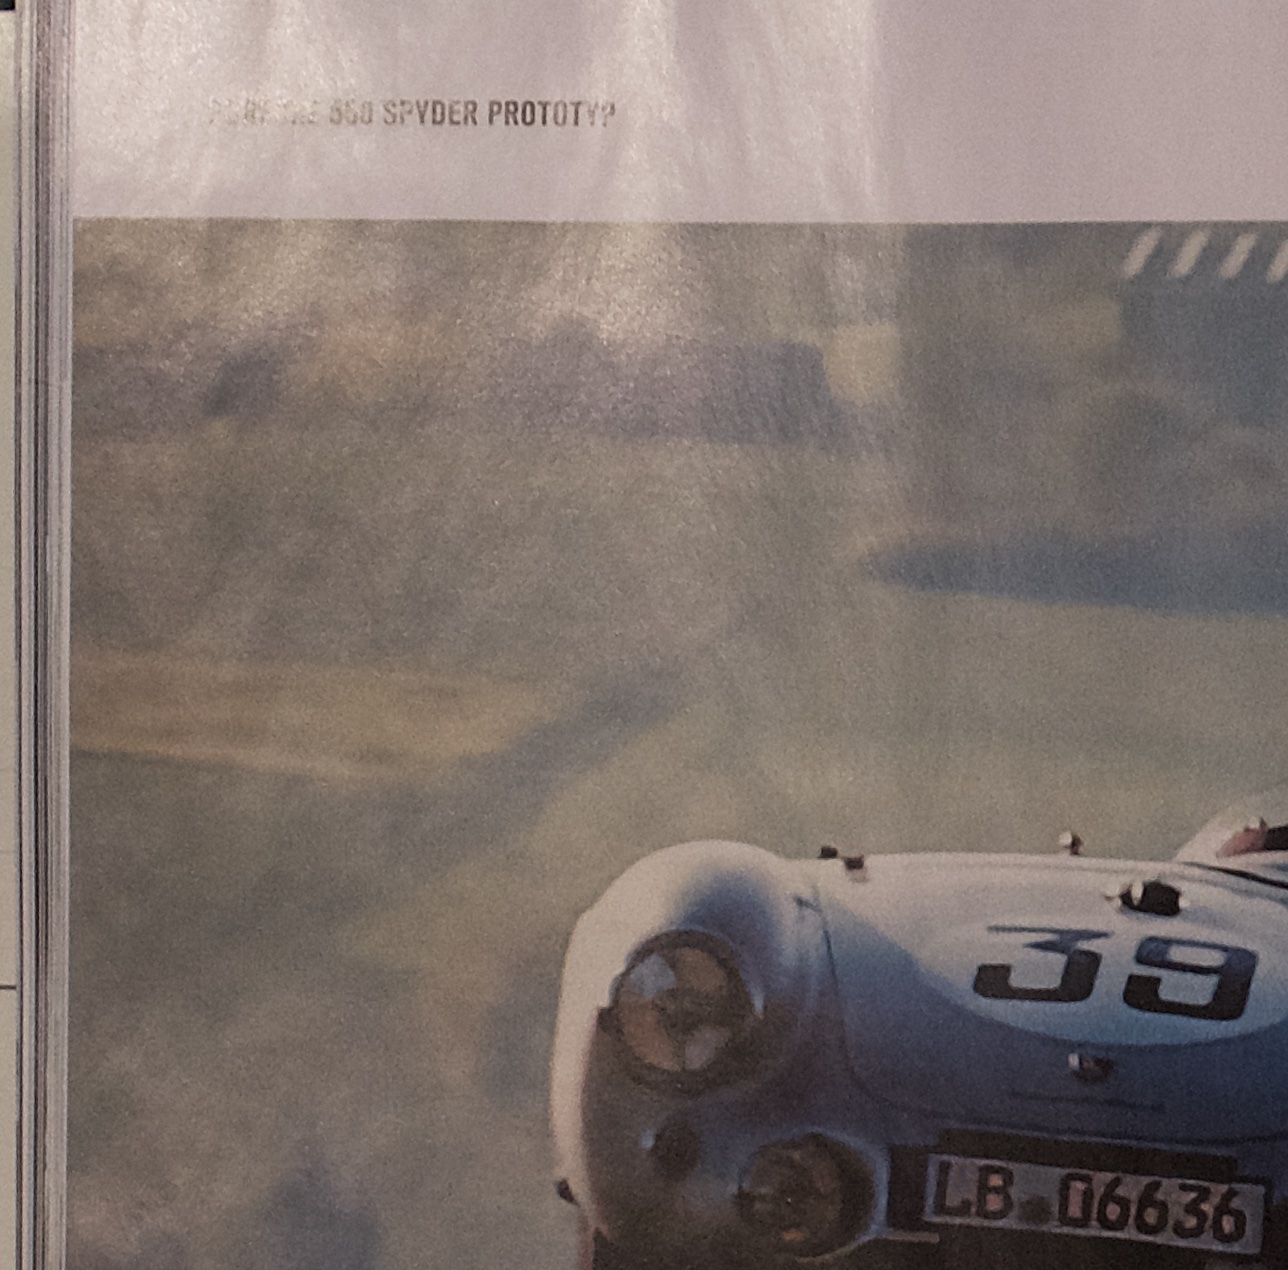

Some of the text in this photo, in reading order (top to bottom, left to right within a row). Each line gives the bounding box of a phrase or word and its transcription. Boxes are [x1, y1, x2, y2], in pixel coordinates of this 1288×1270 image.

[383, 100, 478, 128] SPYDER
[973, 925, 1259, 1021] 39
[933, 1160, 1247, 1244] LB 06636
